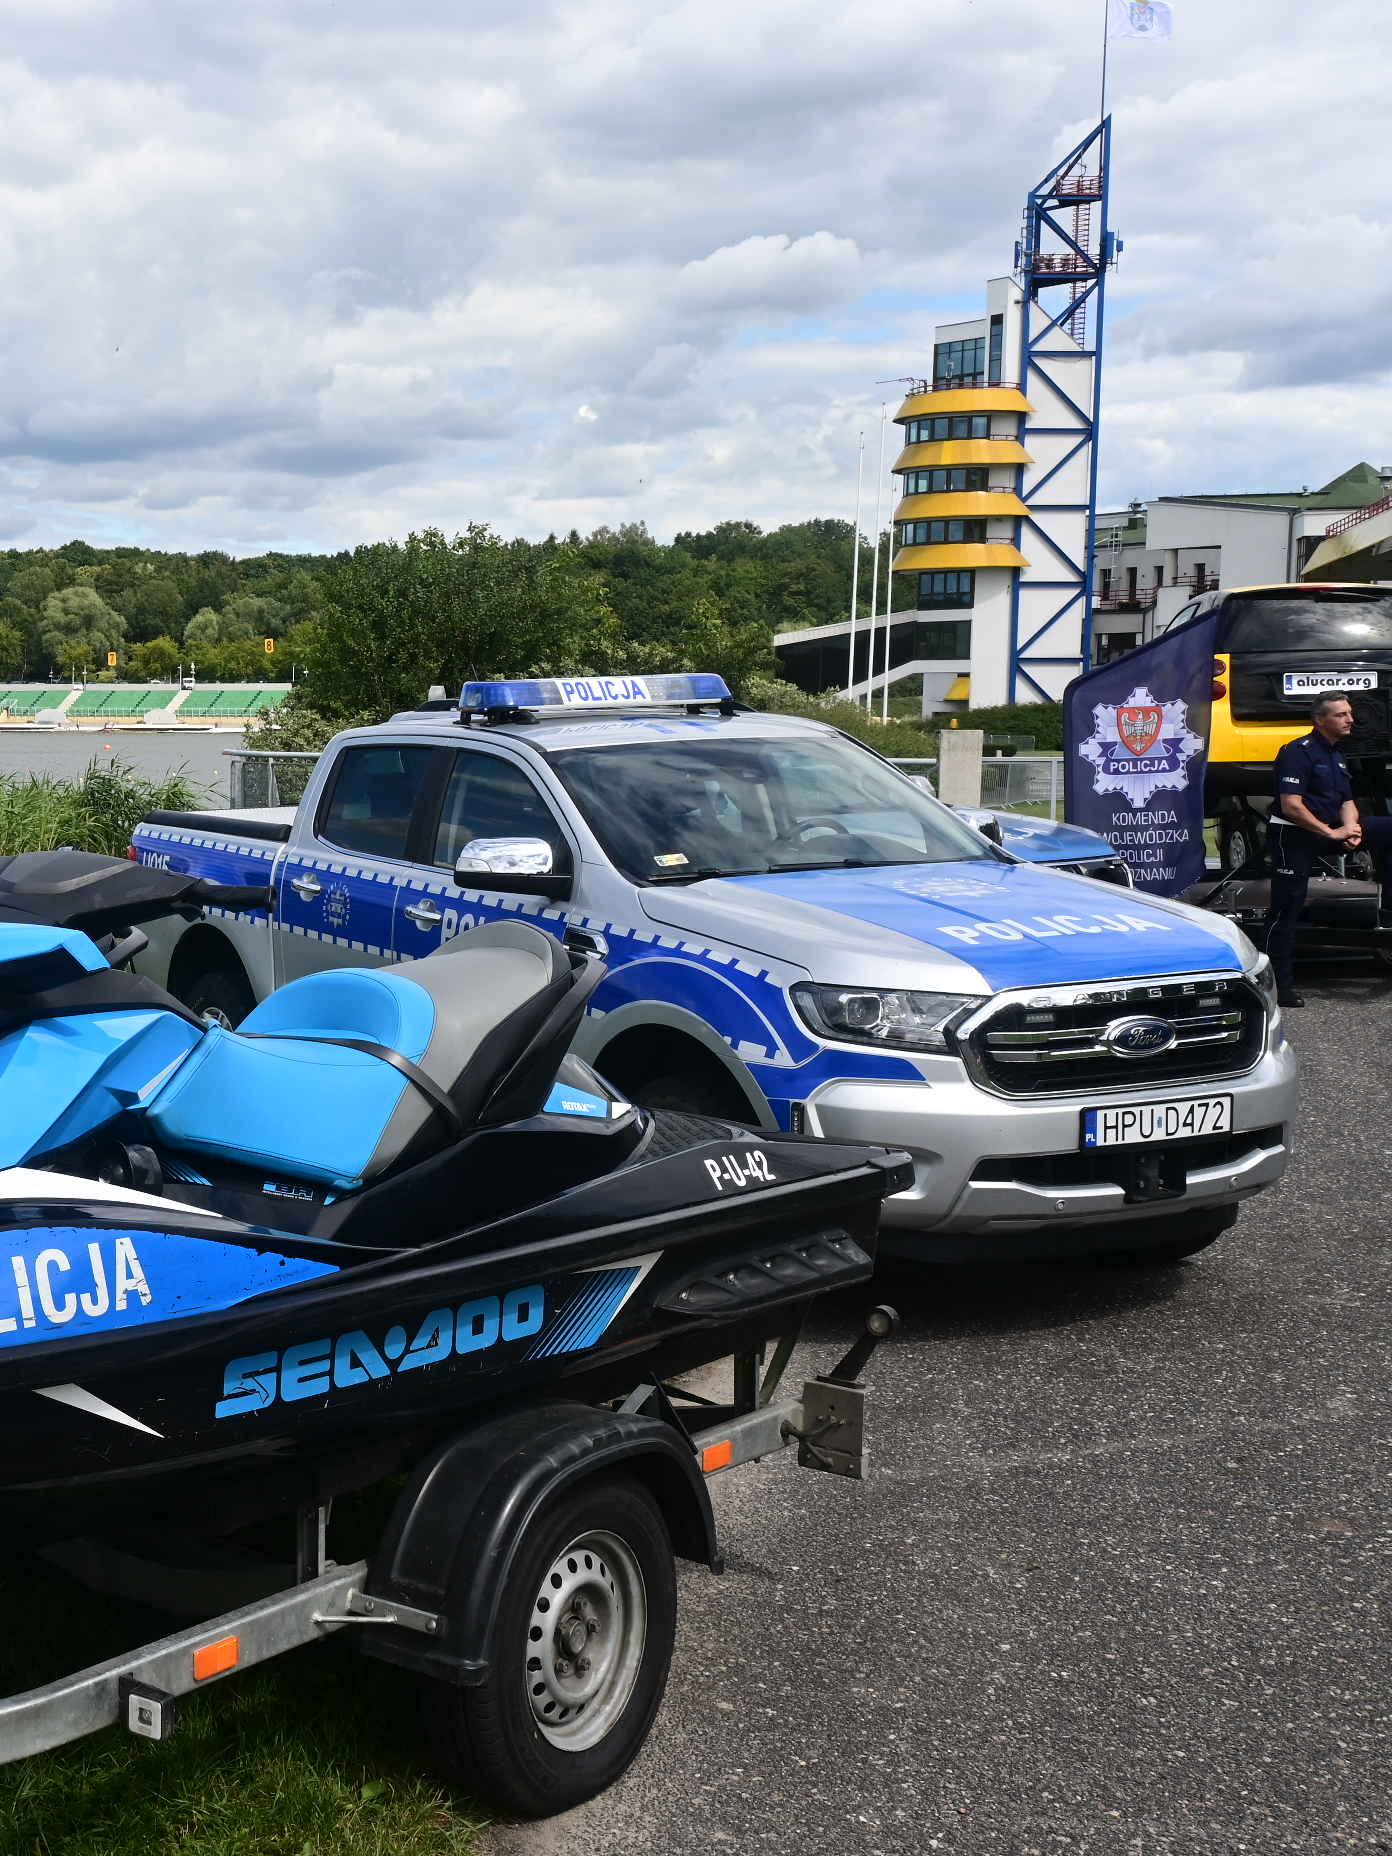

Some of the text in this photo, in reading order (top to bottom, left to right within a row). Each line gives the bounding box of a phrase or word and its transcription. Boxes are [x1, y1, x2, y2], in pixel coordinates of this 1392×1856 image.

[562, 680, 646, 702] POLICJA
[1297, 677, 1371, 688] alucar.org
[1110, 760, 1169, 772] POLICJA
[1112, 810, 1178, 826] KOMENDA
[1120, 848, 1163, 863] POLICJI
[936, 913, 1171, 945] POLICJA
[1129, 1027, 1162, 1046] Ford
[1104, 1101, 1224, 1143] HPU D472
[1085, 1134, 1096, 1142] PL
[704, 1150, 776, 1190] P-U-42
